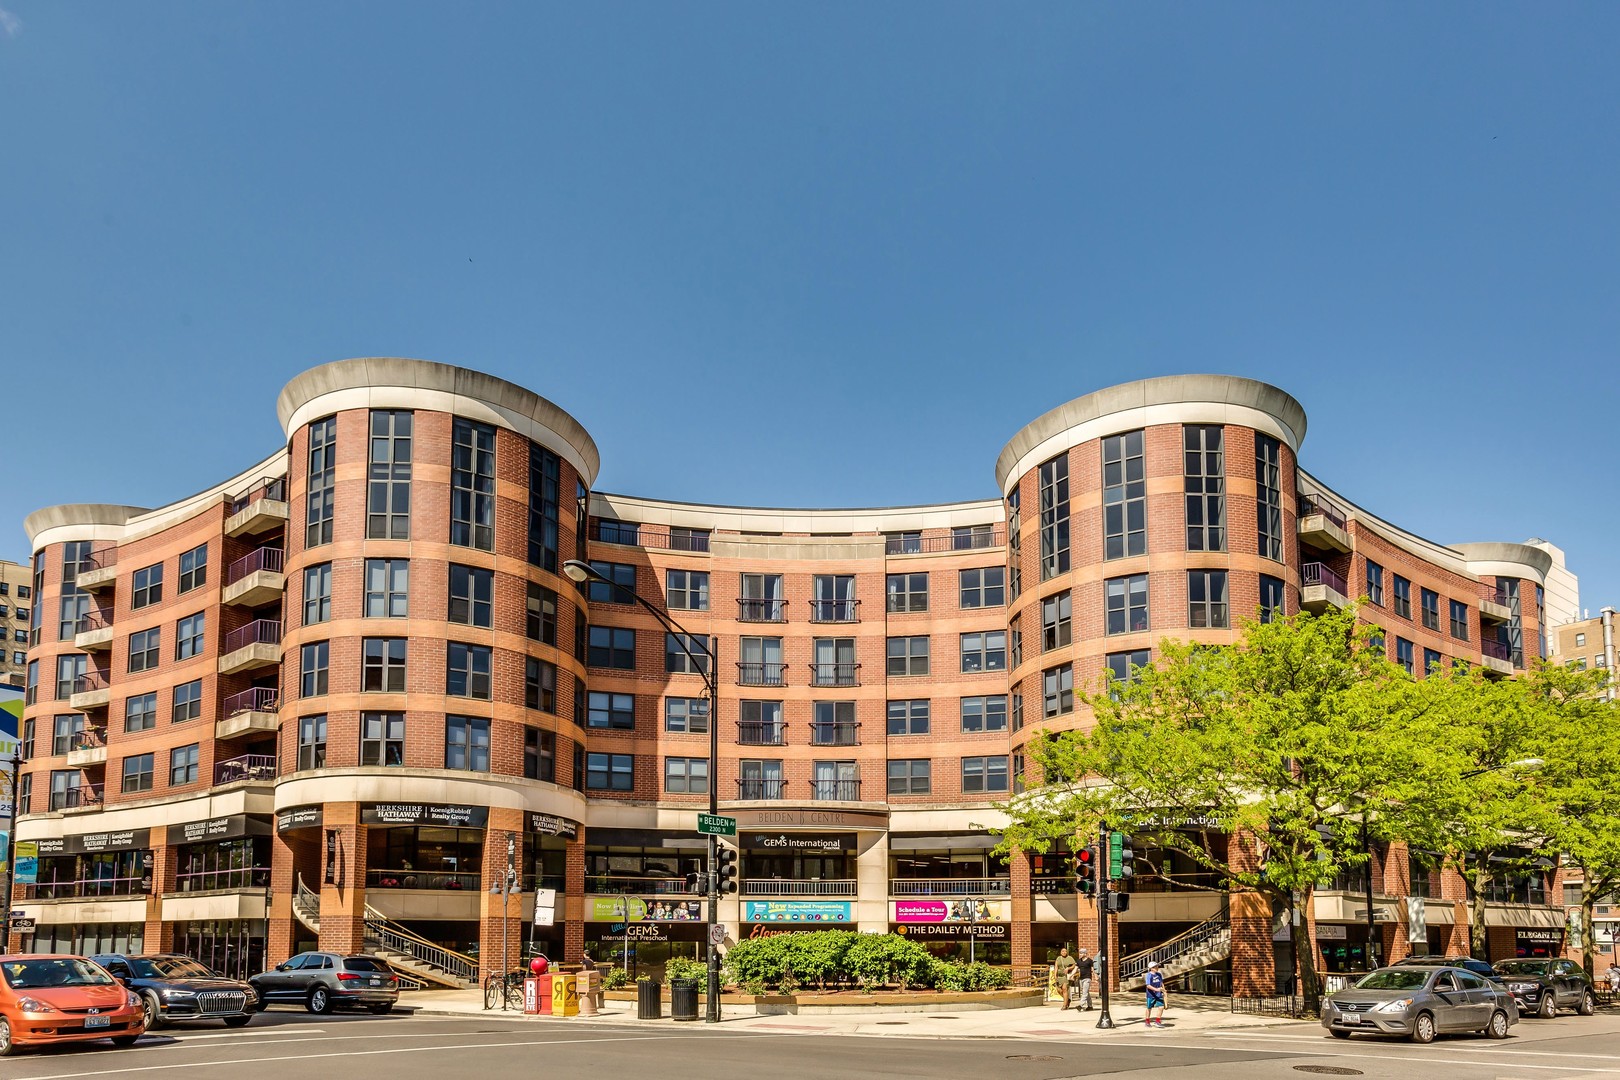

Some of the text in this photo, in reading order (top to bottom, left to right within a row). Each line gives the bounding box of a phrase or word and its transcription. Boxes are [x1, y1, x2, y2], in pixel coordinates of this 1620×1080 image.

[430, 807, 471, 815] KoenigRubloff
[431, 812, 449, 820] Realty
[758, 812, 794, 823] BELDEN
[810, 812, 845, 823] CENTRE
[704, 816, 729, 827] BELDEN
[764, 839, 840, 847] GEMS International
[768, 902, 787, 912] New
[627, 926, 659, 936] GEMS
[908, 926, 1005, 934] THE DAILEY METHOD
[1517, 931, 1550, 939] ELEGANT
